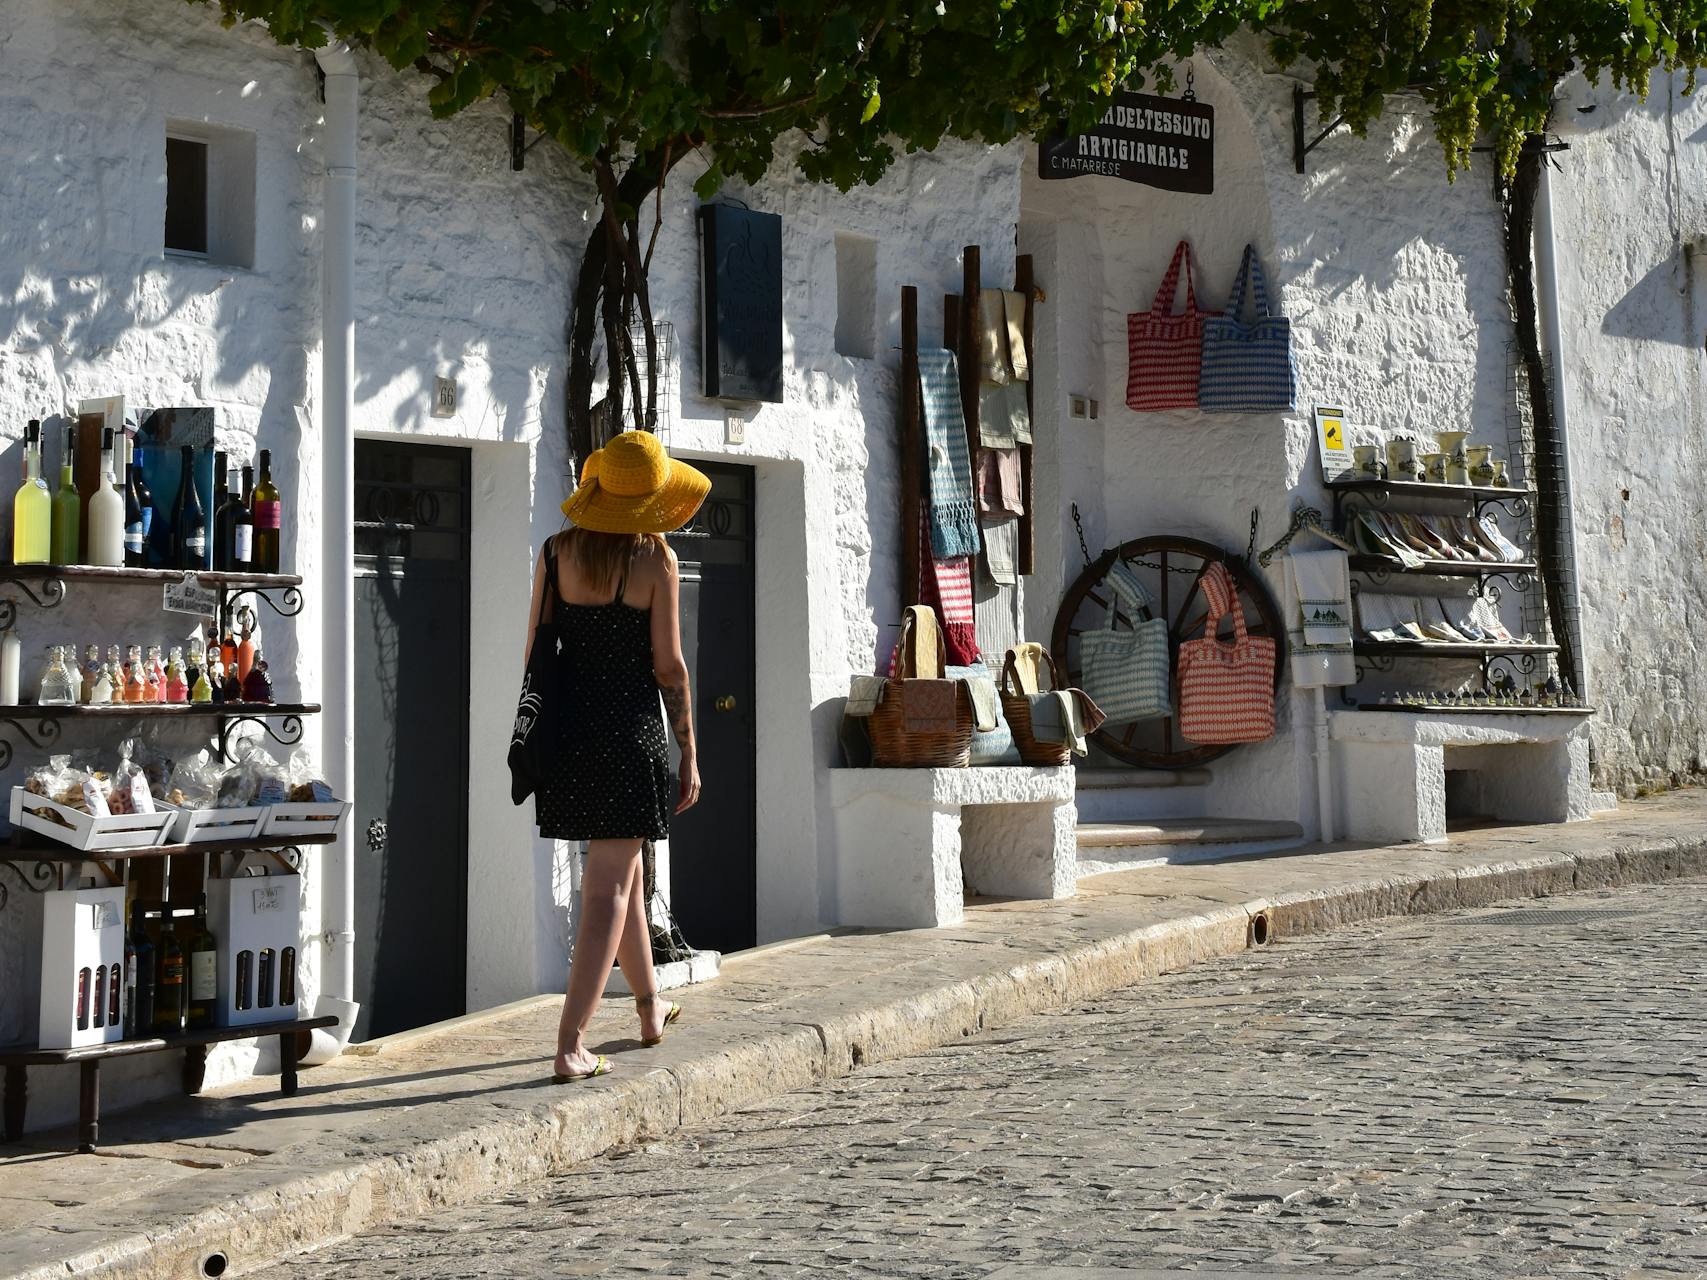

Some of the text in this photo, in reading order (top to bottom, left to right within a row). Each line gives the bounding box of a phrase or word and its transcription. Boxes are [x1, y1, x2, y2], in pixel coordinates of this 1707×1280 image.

[1079, 134, 1189, 170] ARTIGIANALE
[1062, 157, 1121, 176] MATARRESE
[440, 386, 454, 406] 66
[731, 416, 743, 435] 68
